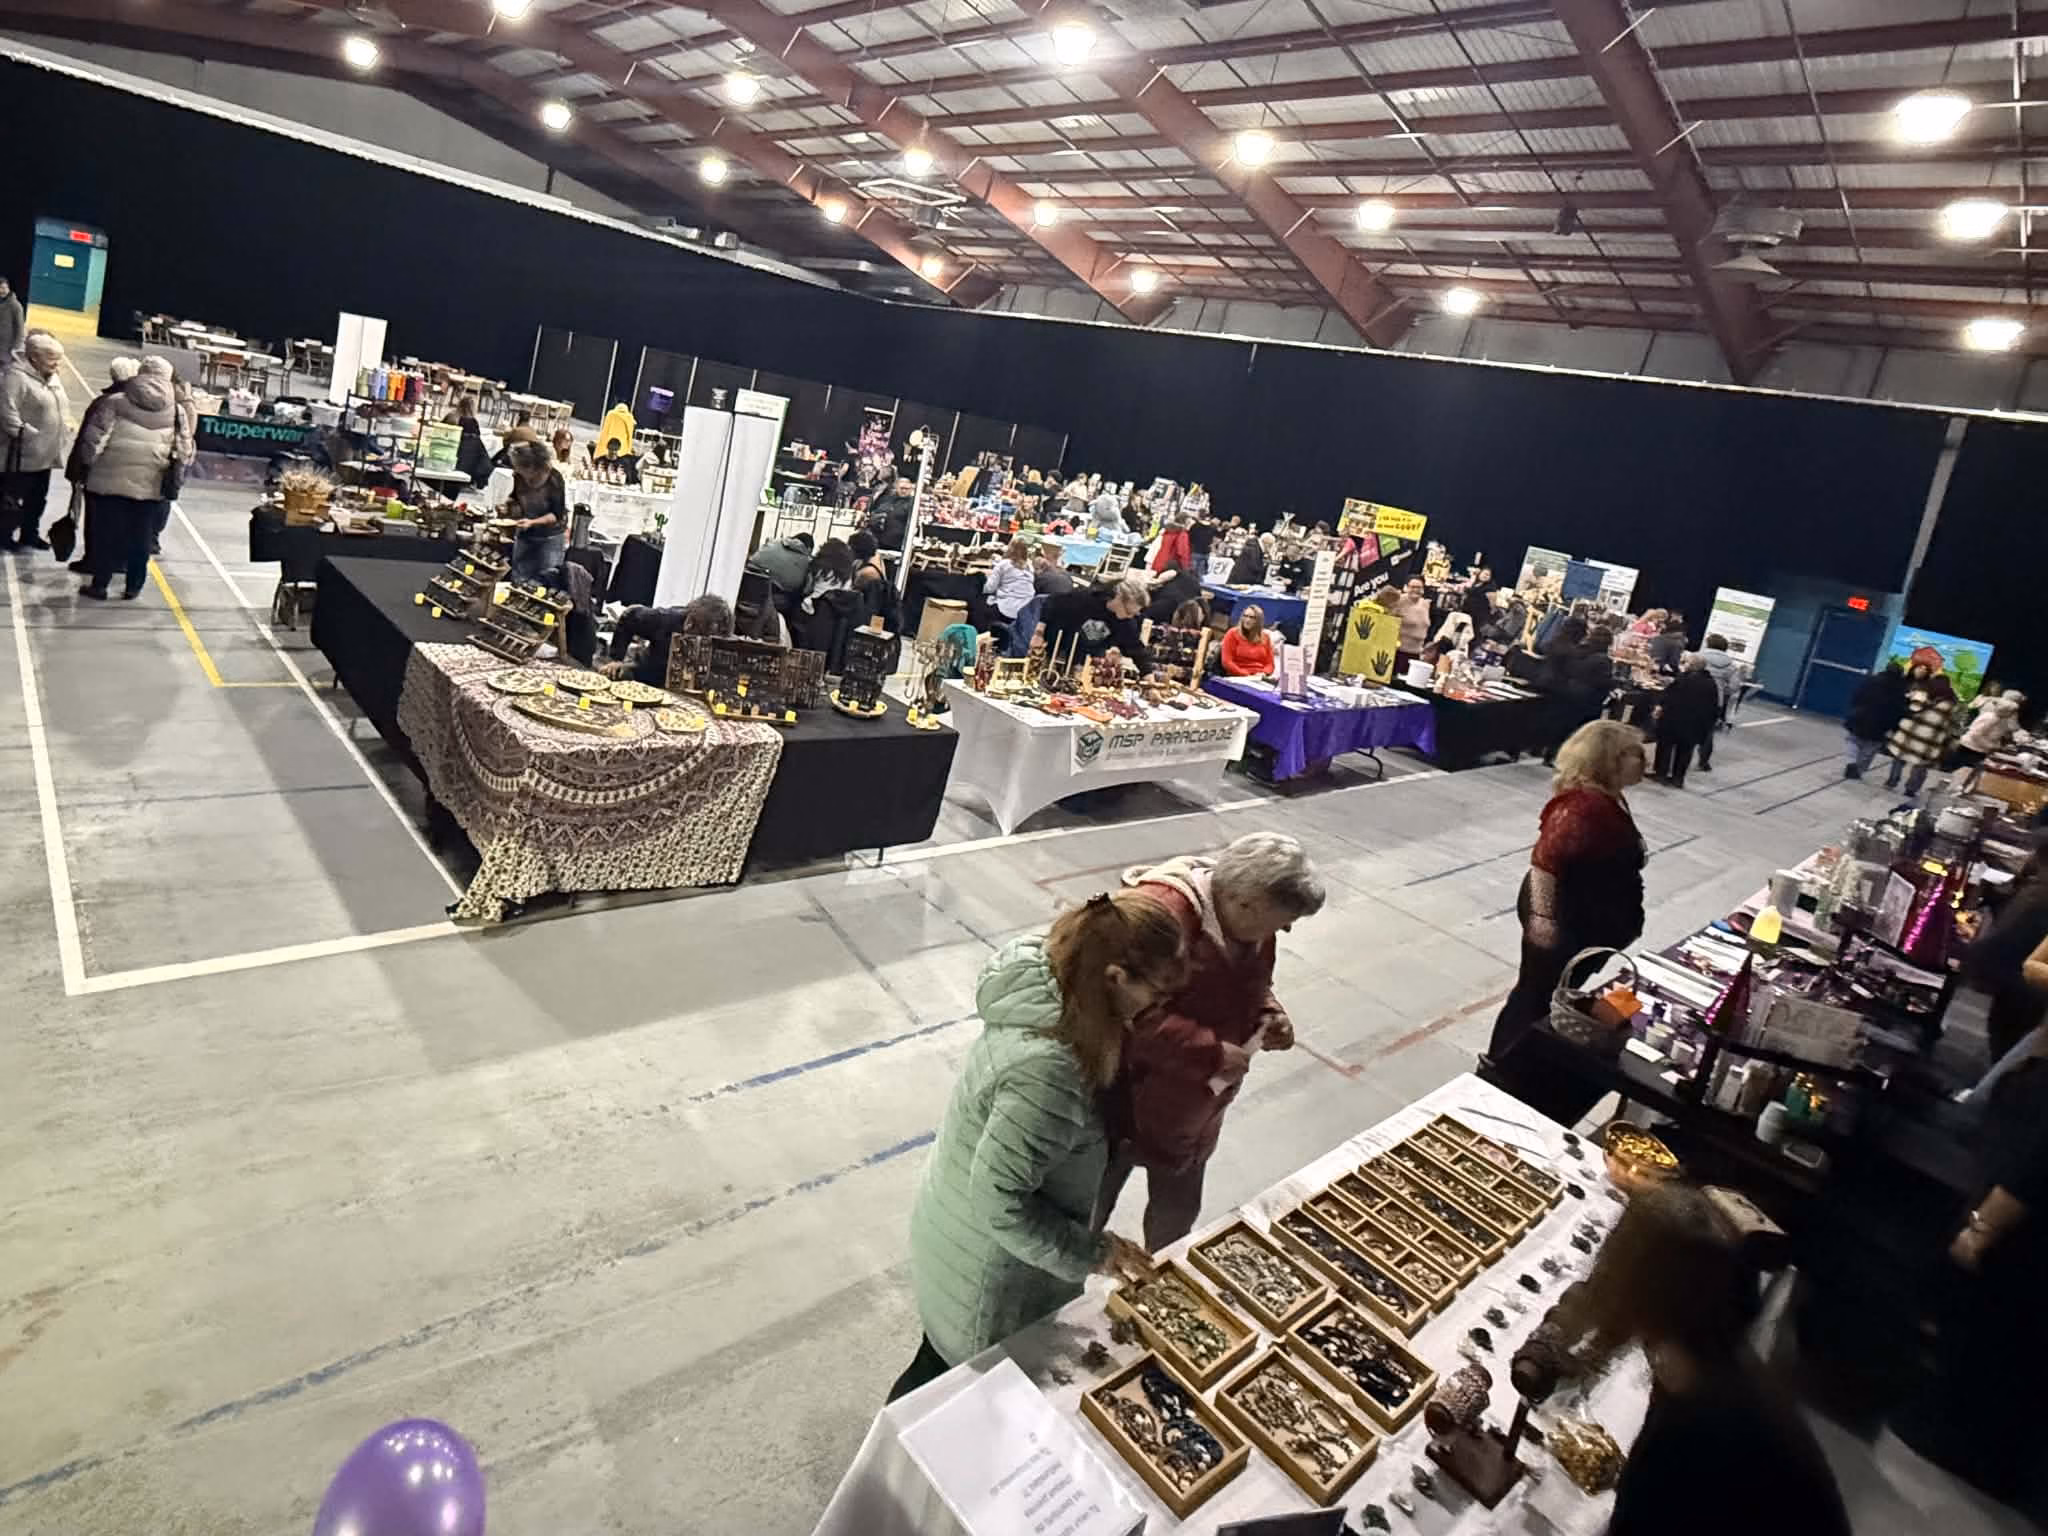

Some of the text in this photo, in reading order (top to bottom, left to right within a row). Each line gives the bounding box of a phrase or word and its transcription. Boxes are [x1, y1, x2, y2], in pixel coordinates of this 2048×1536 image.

[203, 417, 304, 441] Tupperwar
[1370, 571, 1389, 590] you
[1109, 733, 1145, 749] MSP
